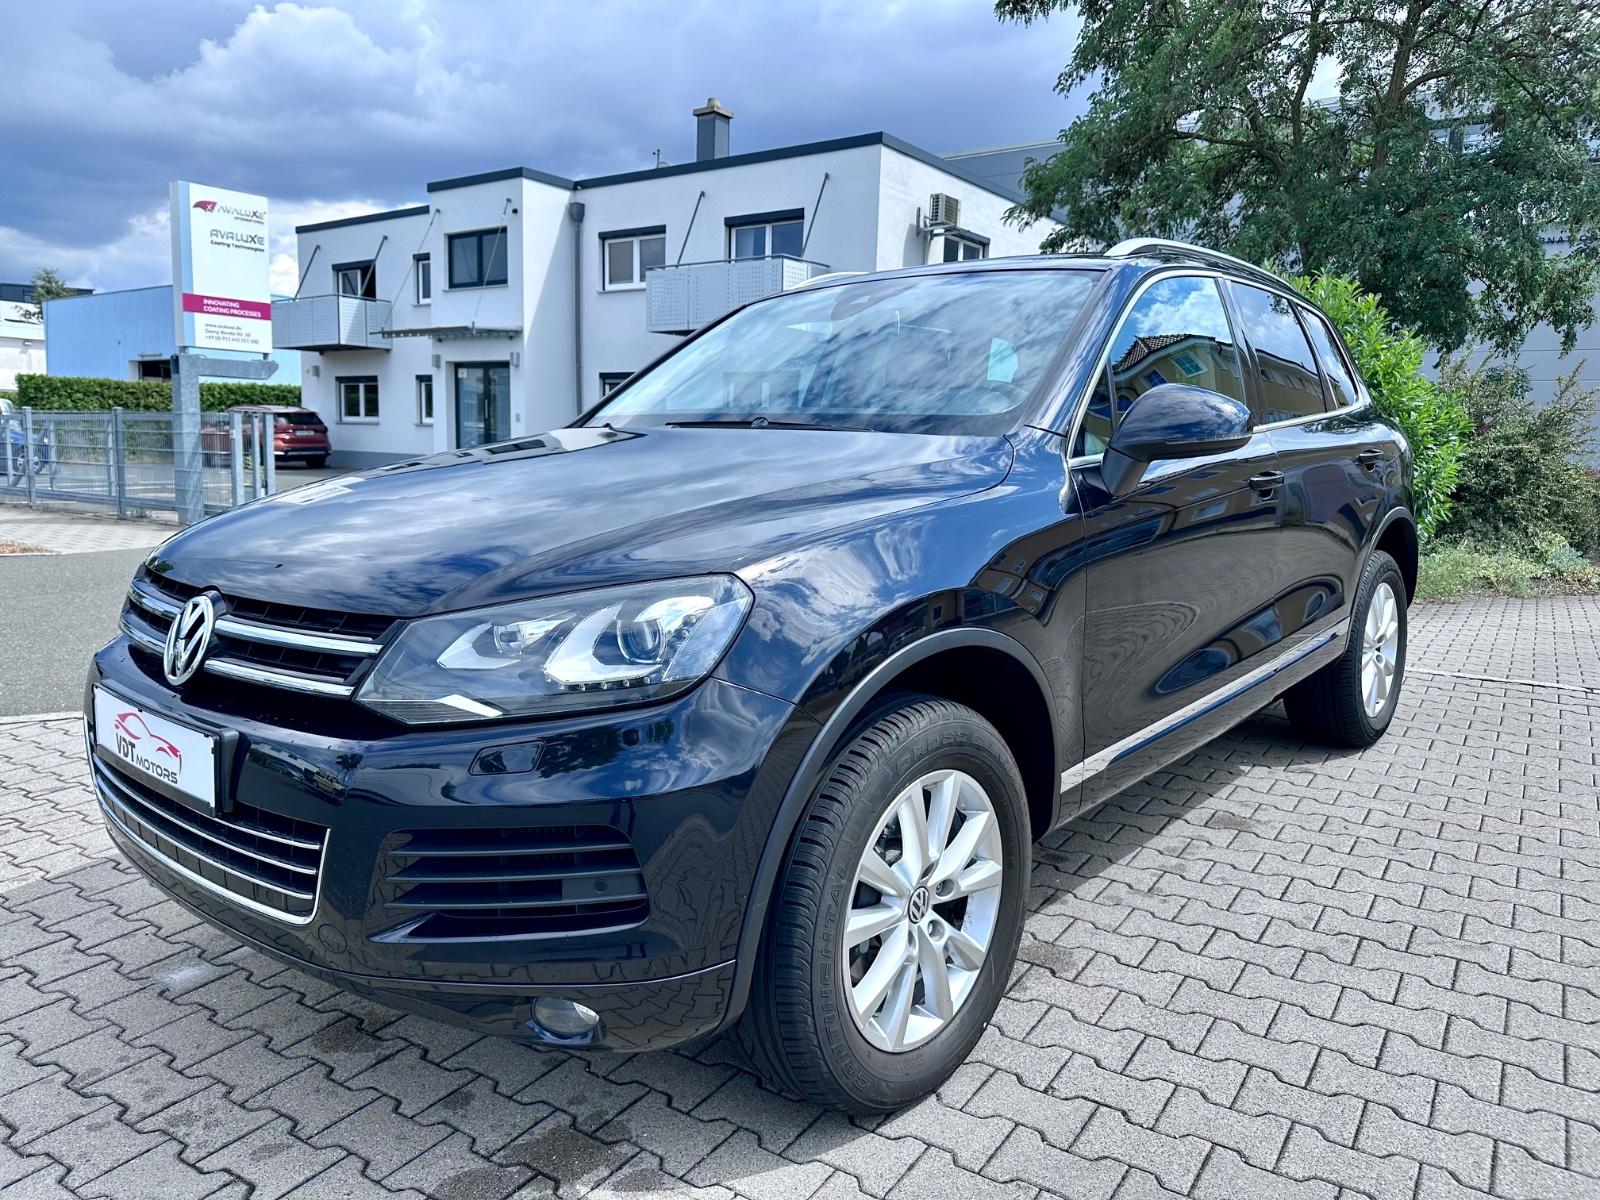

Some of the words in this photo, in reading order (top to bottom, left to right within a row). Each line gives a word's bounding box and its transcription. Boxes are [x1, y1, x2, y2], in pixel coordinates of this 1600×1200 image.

[210, 229, 265, 245] AVALUXE
[210, 240, 230, 248] Coating
[203, 299, 239, 308] INNOVATING
[203, 305, 230, 315] COATING
[230, 308, 262, 318] PROCESSES
[116, 732, 136, 763] VDT
[136, 753, 178, 785] MOTORS
